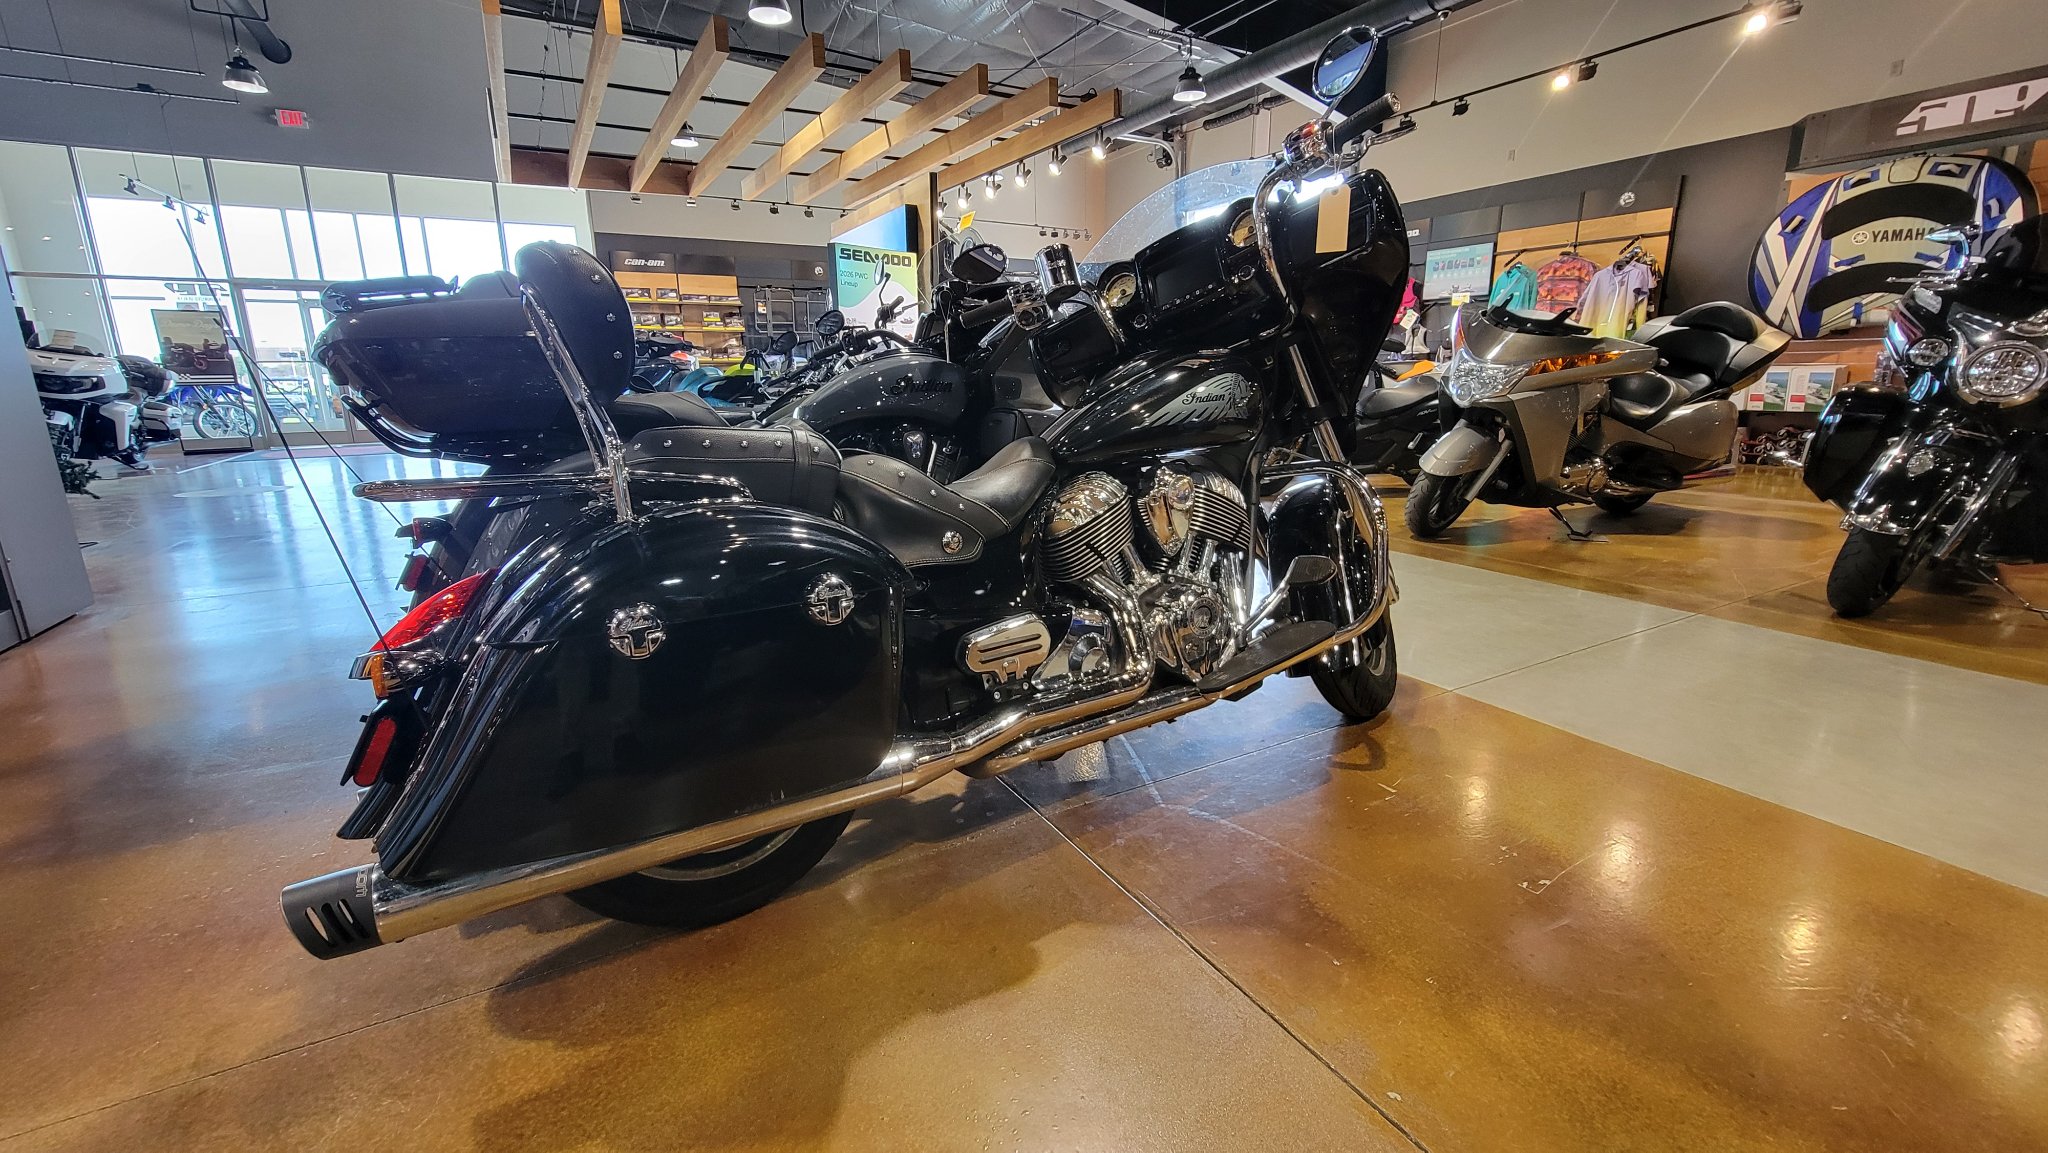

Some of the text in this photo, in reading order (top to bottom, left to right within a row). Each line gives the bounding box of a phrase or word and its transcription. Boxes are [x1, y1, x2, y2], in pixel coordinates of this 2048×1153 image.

[279, 110, 303, 126] EXIT
[839, 270, 868, 280] 2026 PWC
[841, 279, 858, 288] Lineup
[1181, 391, 1226, 406] Indian
